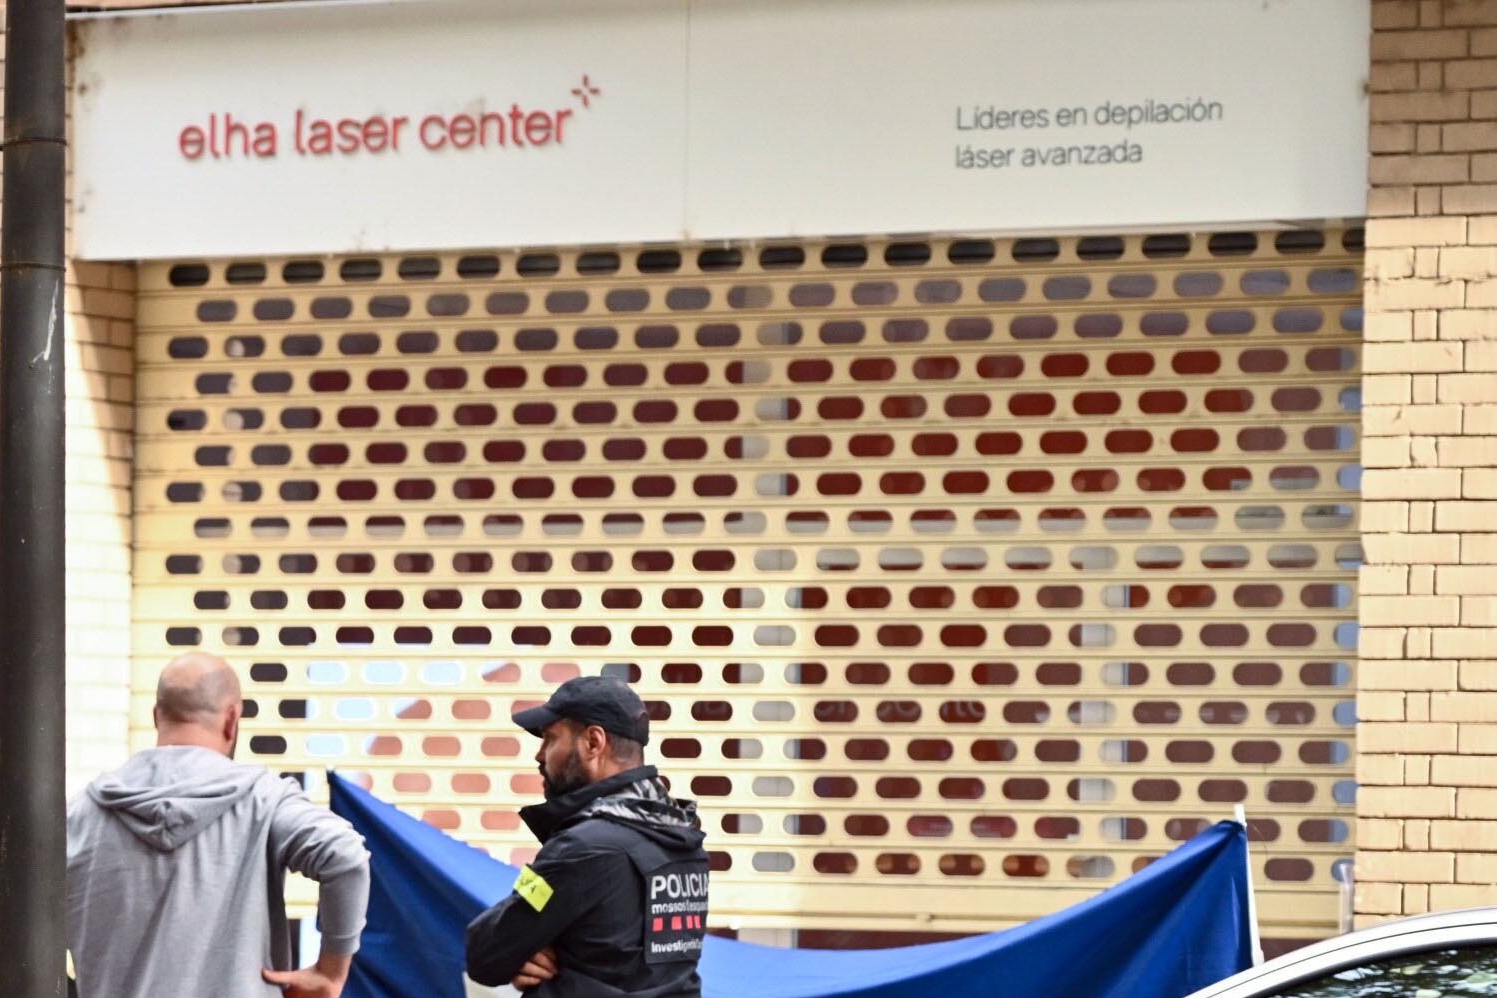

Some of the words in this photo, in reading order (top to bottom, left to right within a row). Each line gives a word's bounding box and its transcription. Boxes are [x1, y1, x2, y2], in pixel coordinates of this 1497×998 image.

[955, 104, 1050, 131] Líderes
[1055, 106, 1088, 128] en
[1094, 96, 1224, 130] depilación
[178, 112, 278, 160] elha
[295, 108, 409, 156] laser
[418, 103, 573, 152] center
[954, 144, 1014, 169] láser
[1020, 138, 1144, 168] avanzada
